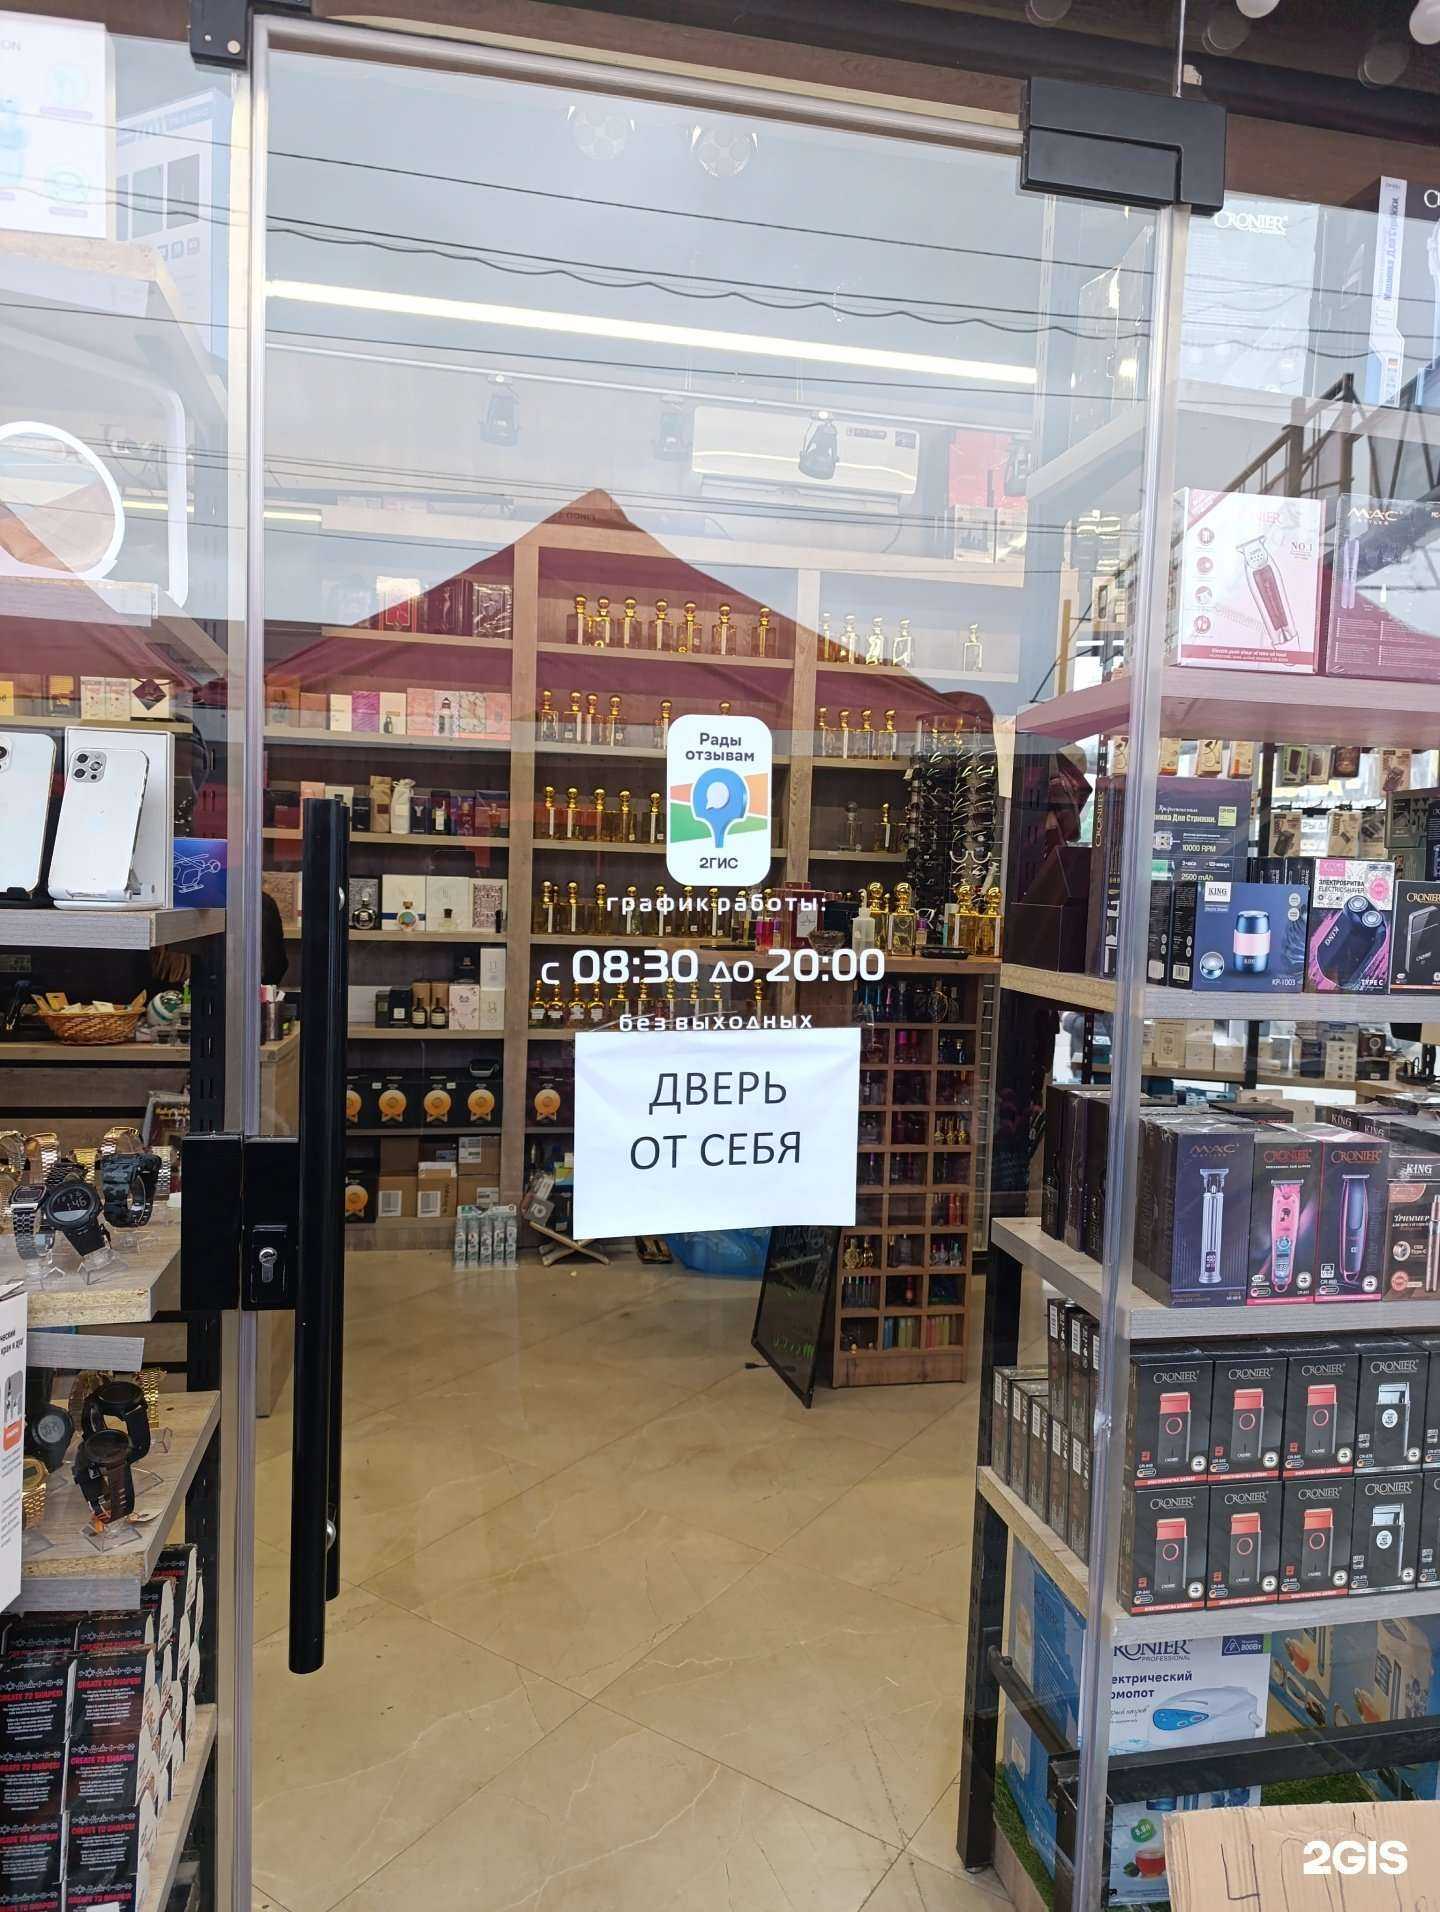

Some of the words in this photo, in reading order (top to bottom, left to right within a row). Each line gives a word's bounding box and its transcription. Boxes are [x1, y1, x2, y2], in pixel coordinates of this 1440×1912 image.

[699, 733, 742, 749] Рады
[685, 747, 755, 762] отзывам
[1182, 844, 1200, 852] 10000
[699, 856, 739, 870] 2ГИС
[1181, 873, 1197, 881] 2500
[606, 895, 709, 914] график
[717, 893, 828, 915] работы:
[572, 949, 699, 985] 08:30
[709, 959, 755, 983] до
[766, 948, 886, 983] 20:00
[619, 1014, 668, 1032] без
[675, 1012, 813, 1031] выходных
[648, 1071, 788, 1115] ДВЕРЬ
[1331, 1113, 1352, 1126] KING
[1364, 1124, 1385, 1137] KING
[630, 1134, 688, 1170] ОТ
[700, 1130, 802, 1166] СЕБЯ
[1331, 1150, 1380, 1163] CRONIER
[1406, 1164, 1432, 1174] KING
[1228, 1368, 1271, 1380] CRONIER
[1301, 1365, 1342, 1377] CRONIER
[1370, 1361, 1415, 1374] CRONIER
[1154, 1371, 1197, 1384] CRONIER
[1298, 1488, 1339, 1500] CRONIER
[1364, 1482, 1411, 1496] CRONIER
[1150, 1498, 1193, 1510] CRONIER
[1224, 1493, 1265, 1505] CRONIER
[1112, 1671, 1193, 1686] ектрический
[1111, 1690, 1155, 1699] омопот
